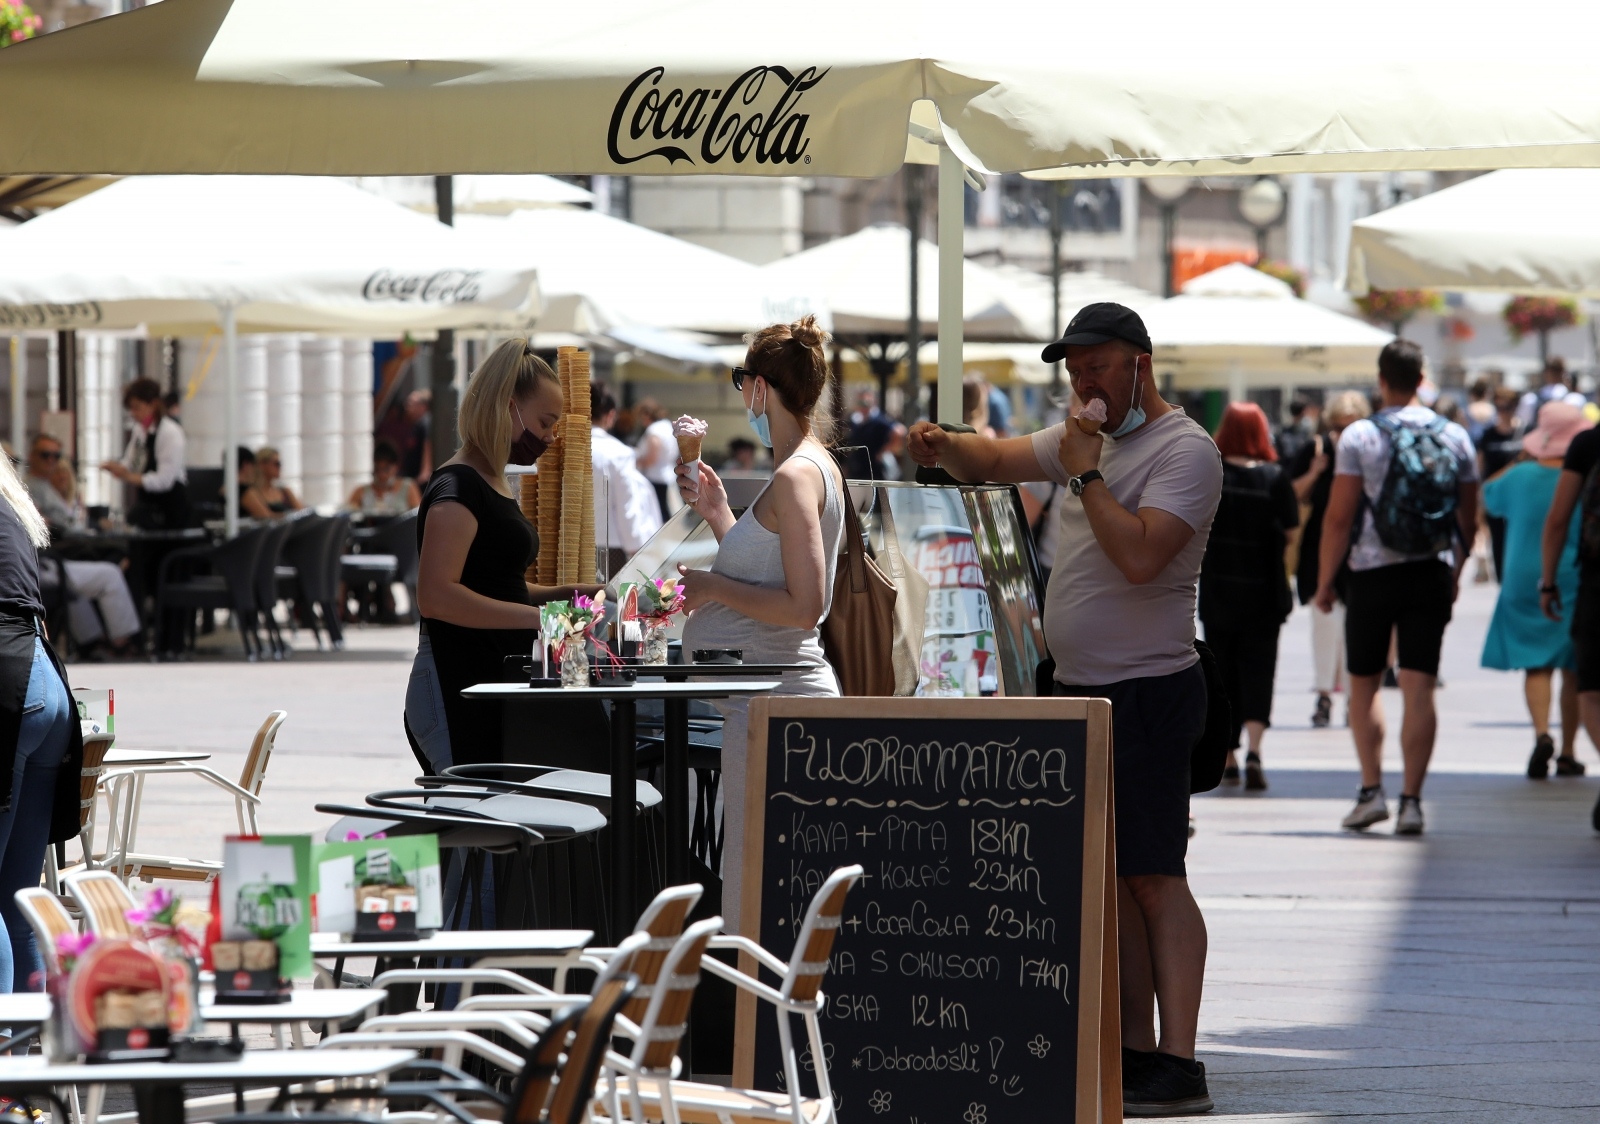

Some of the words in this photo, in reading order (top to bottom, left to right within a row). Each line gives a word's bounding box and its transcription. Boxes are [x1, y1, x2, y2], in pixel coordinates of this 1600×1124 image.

[792, 812, 848, 852] KAVA
[880, 815, 947, 850] PITA
[871, 950, 888, 972] S
